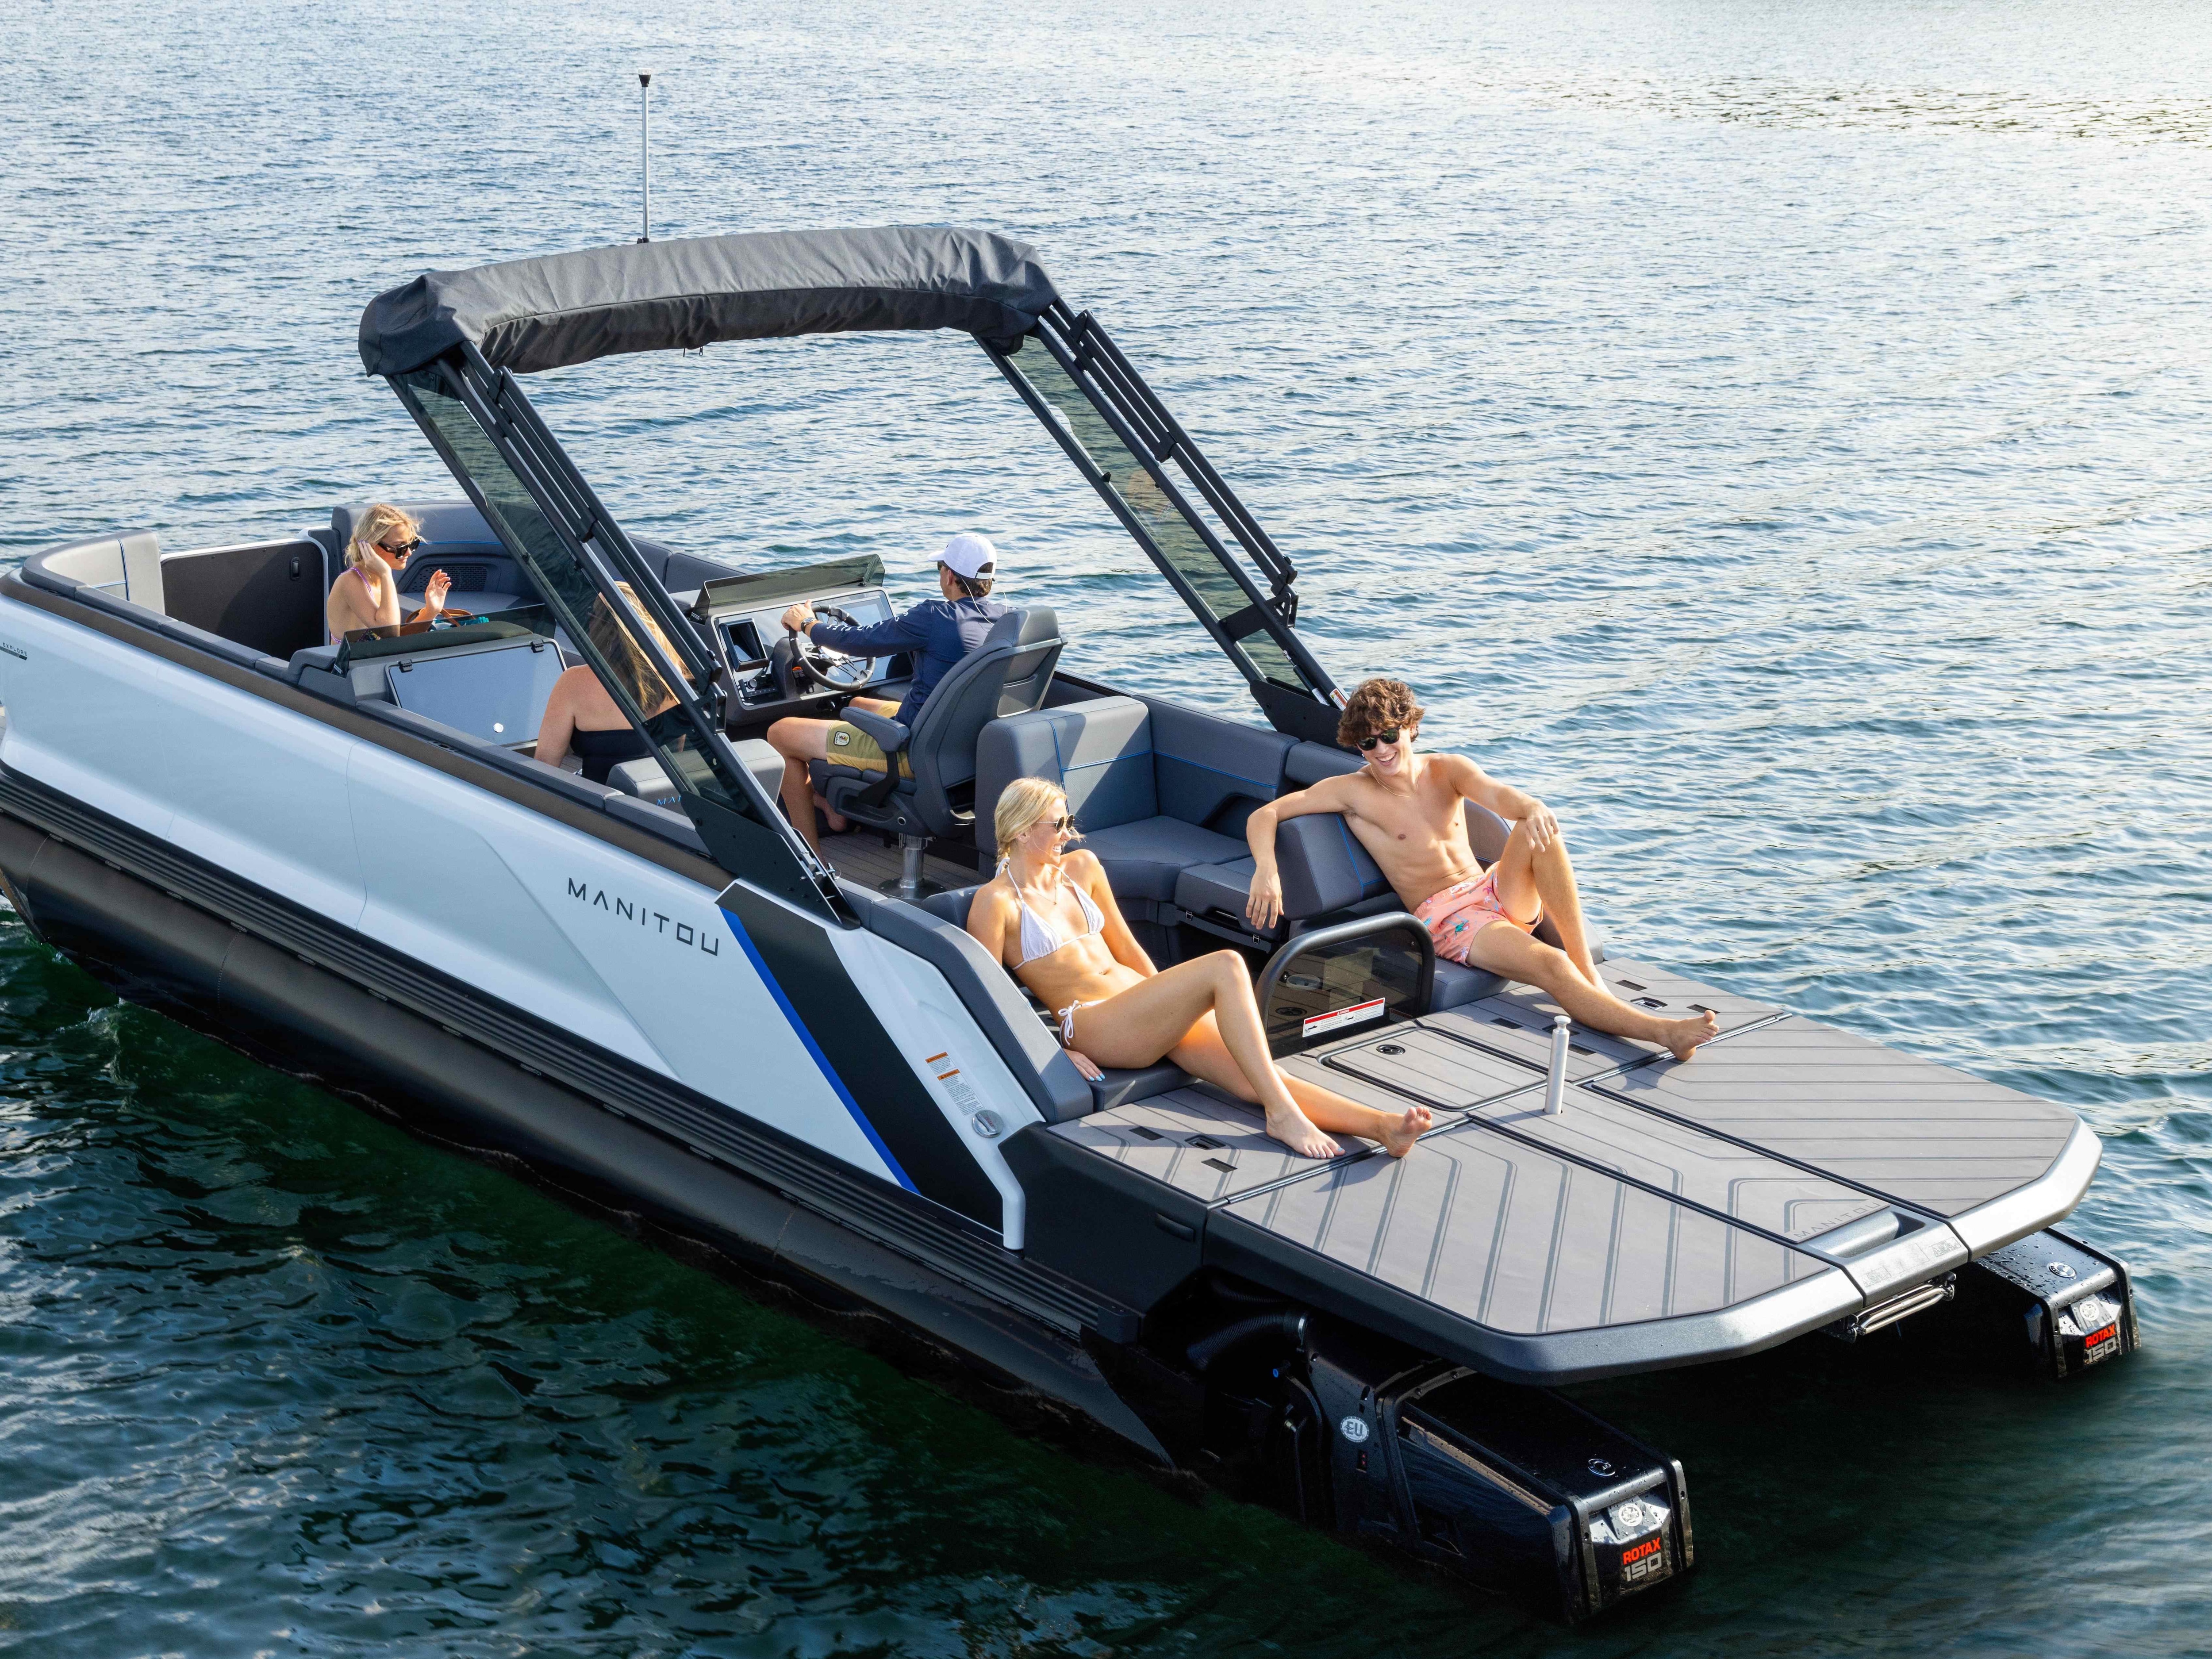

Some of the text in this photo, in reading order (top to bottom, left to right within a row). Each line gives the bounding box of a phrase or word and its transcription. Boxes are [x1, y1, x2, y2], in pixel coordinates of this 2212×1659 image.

[3, 642, 27, 656] EXPLORE
[568, 877, 719, 956] MANITOU
[1793, 1202, 1881, 1238] MANITOU
[2085, 1324, 2116, 1348] ROTAX
[2086, 1337, 2116, 1363] 150
[1622, 1537, 1661, 1565] ROTAX
[1624, 1552, 1662, 1582] 150
